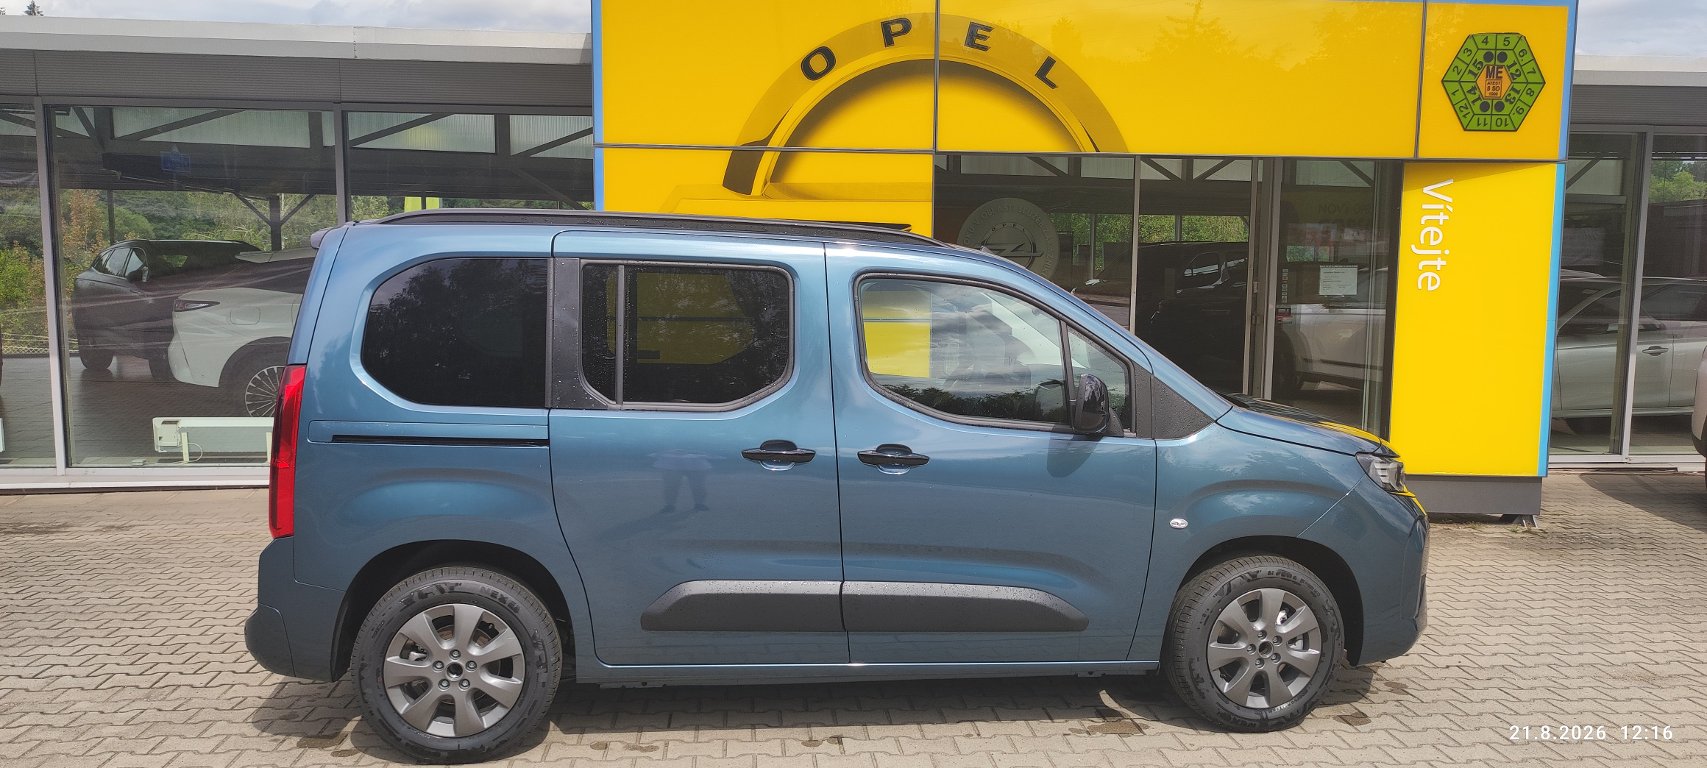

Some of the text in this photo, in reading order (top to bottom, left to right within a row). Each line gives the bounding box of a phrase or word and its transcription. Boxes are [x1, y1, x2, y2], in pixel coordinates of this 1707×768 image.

[1481, 35, 1489, 45] 4
[1503, 37, 1511, 47] 5
[800, 17, 1058, 89] OPEL
[1463, 47, 1473, 57] 3
[1452, 65, 1463, 76] 2
[1468, 58, 1484, 78] 15
[1485, 65, 1503, 79] ME
[1506, 60, 1522, 80] 12
[1527, 67, 1536, 75] 7
[1466, 85, 1483, 105] 14
[1504, 85, 1522, 104] 13
[1525, 88, 1535, 97] 8
[1458, 102, 1471, 119] 12
[1476, 117, 1488, 127] 11
[1495, 117, 1509, 127] 10
[1410, 178, 1454, 291] Vítejte
